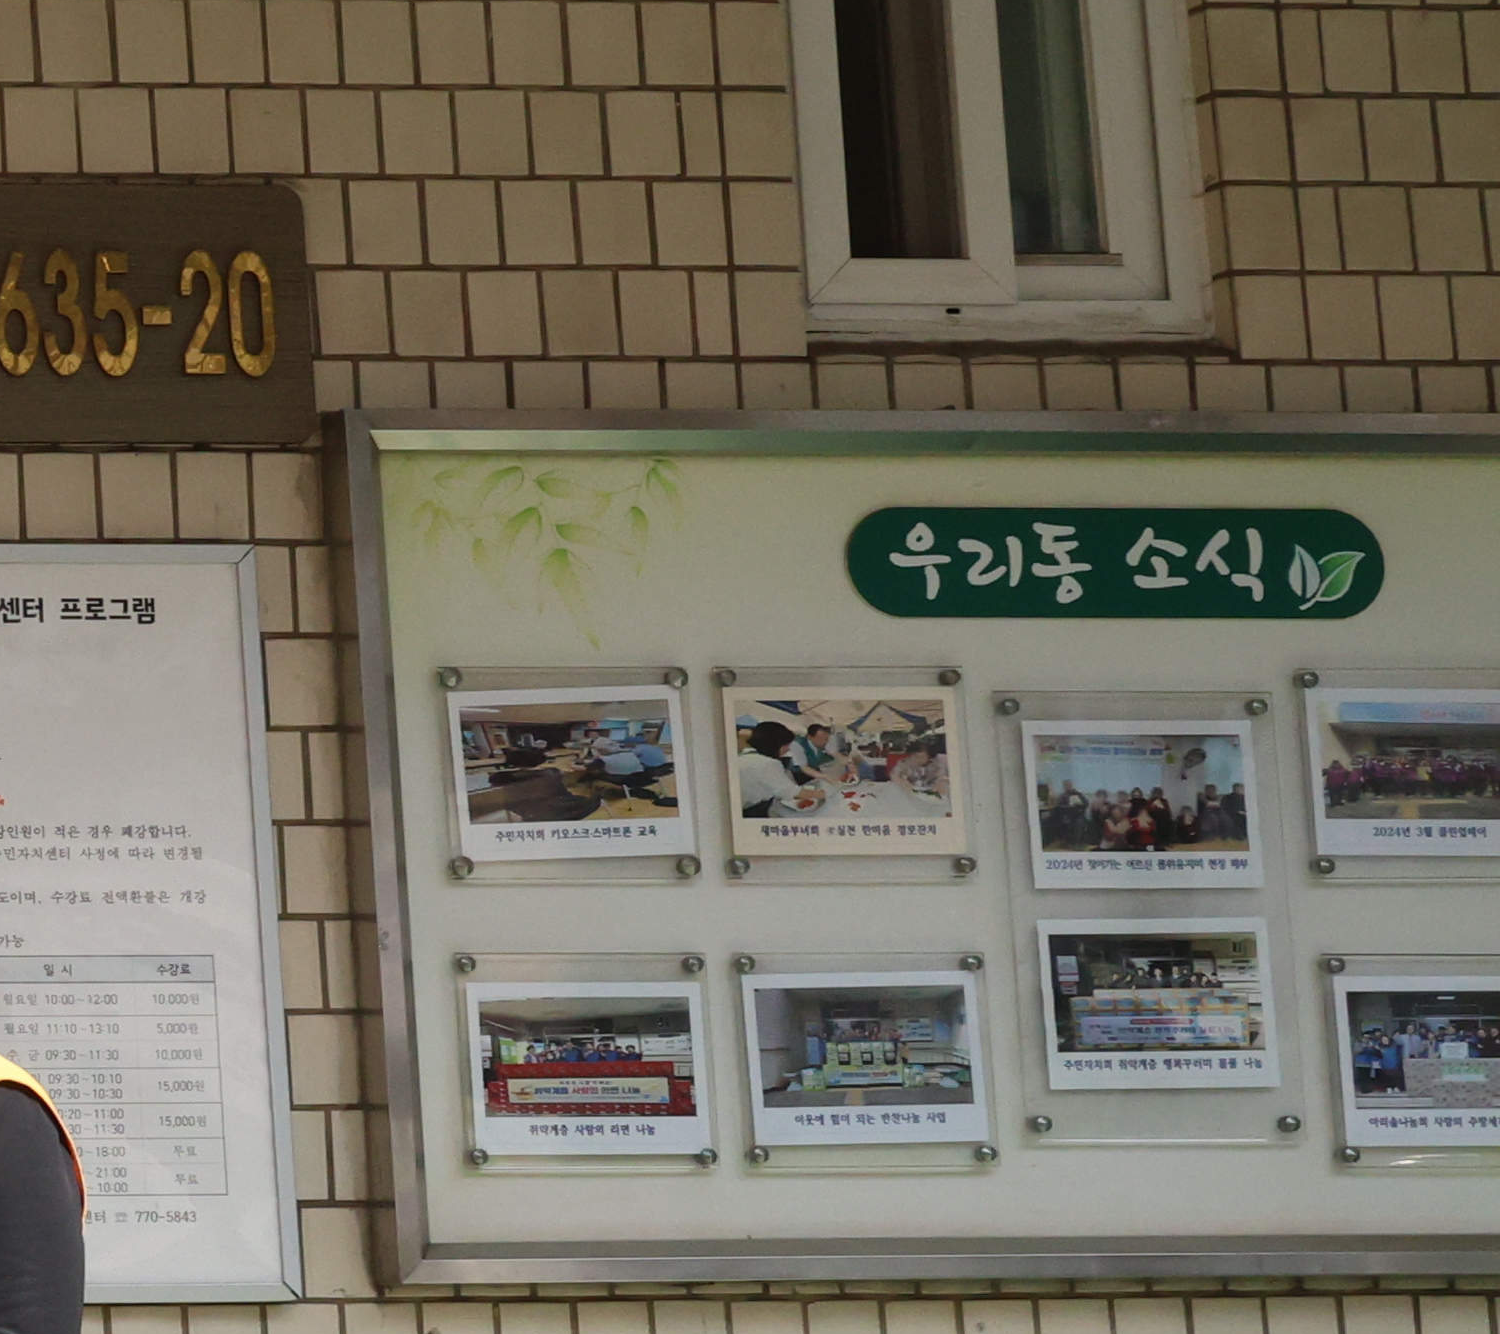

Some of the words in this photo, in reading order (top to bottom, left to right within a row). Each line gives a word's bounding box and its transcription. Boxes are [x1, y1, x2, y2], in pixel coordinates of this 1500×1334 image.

[889, 522, 1093, 606] 우리동
[1124, 525, 1267, 602] 소식
[60, 597, 156, 625] 프로그램
[54, 825, 80, 839] 적은
[88, 825, 113, 839] 경우
[638, 825, 657, 837] 교육
[1373, 827, 1410, 838] 2024년
[128, 847, 155, 860] 따라
[50, 891, 91, 905] 수강료
[180, 890, 206, 904] 개강
[156, 964, 191, 976] 수강료
[173, 1145, 197, 1157] 무료
[175, 1174, 198, 1186] 무료
[135, 1211, 197, 1223] 770-5843
